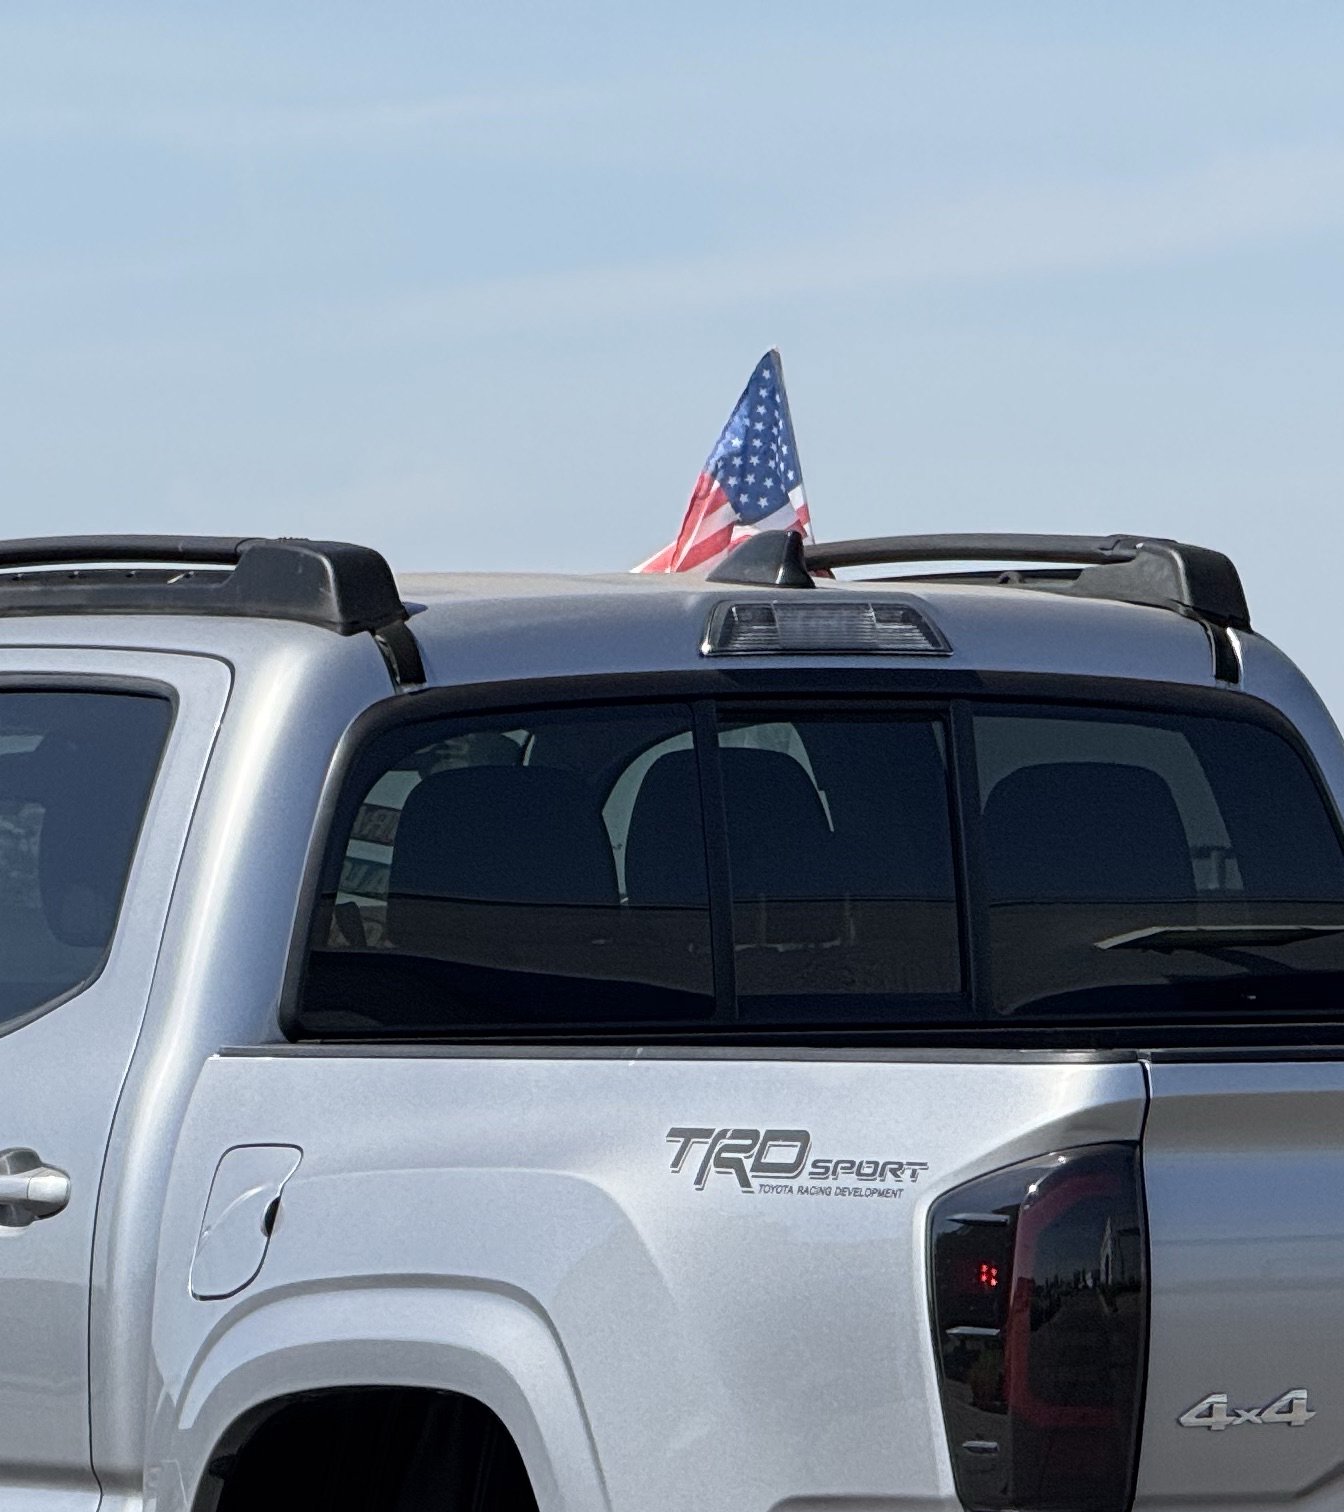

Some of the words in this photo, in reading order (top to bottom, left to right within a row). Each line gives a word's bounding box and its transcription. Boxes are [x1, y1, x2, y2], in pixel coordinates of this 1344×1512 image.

[666, 1127, 810, 1193] TRD
[808, 1159, 928, 1182] SPORT
[758, 1184, 794, 1195] TOYOTA
[797, 1185, 832, 1196] RACING
[834, 1187, 905, 1198] DEVELOPMENT
[1177, 1388, 1316, 1431] 4x4
